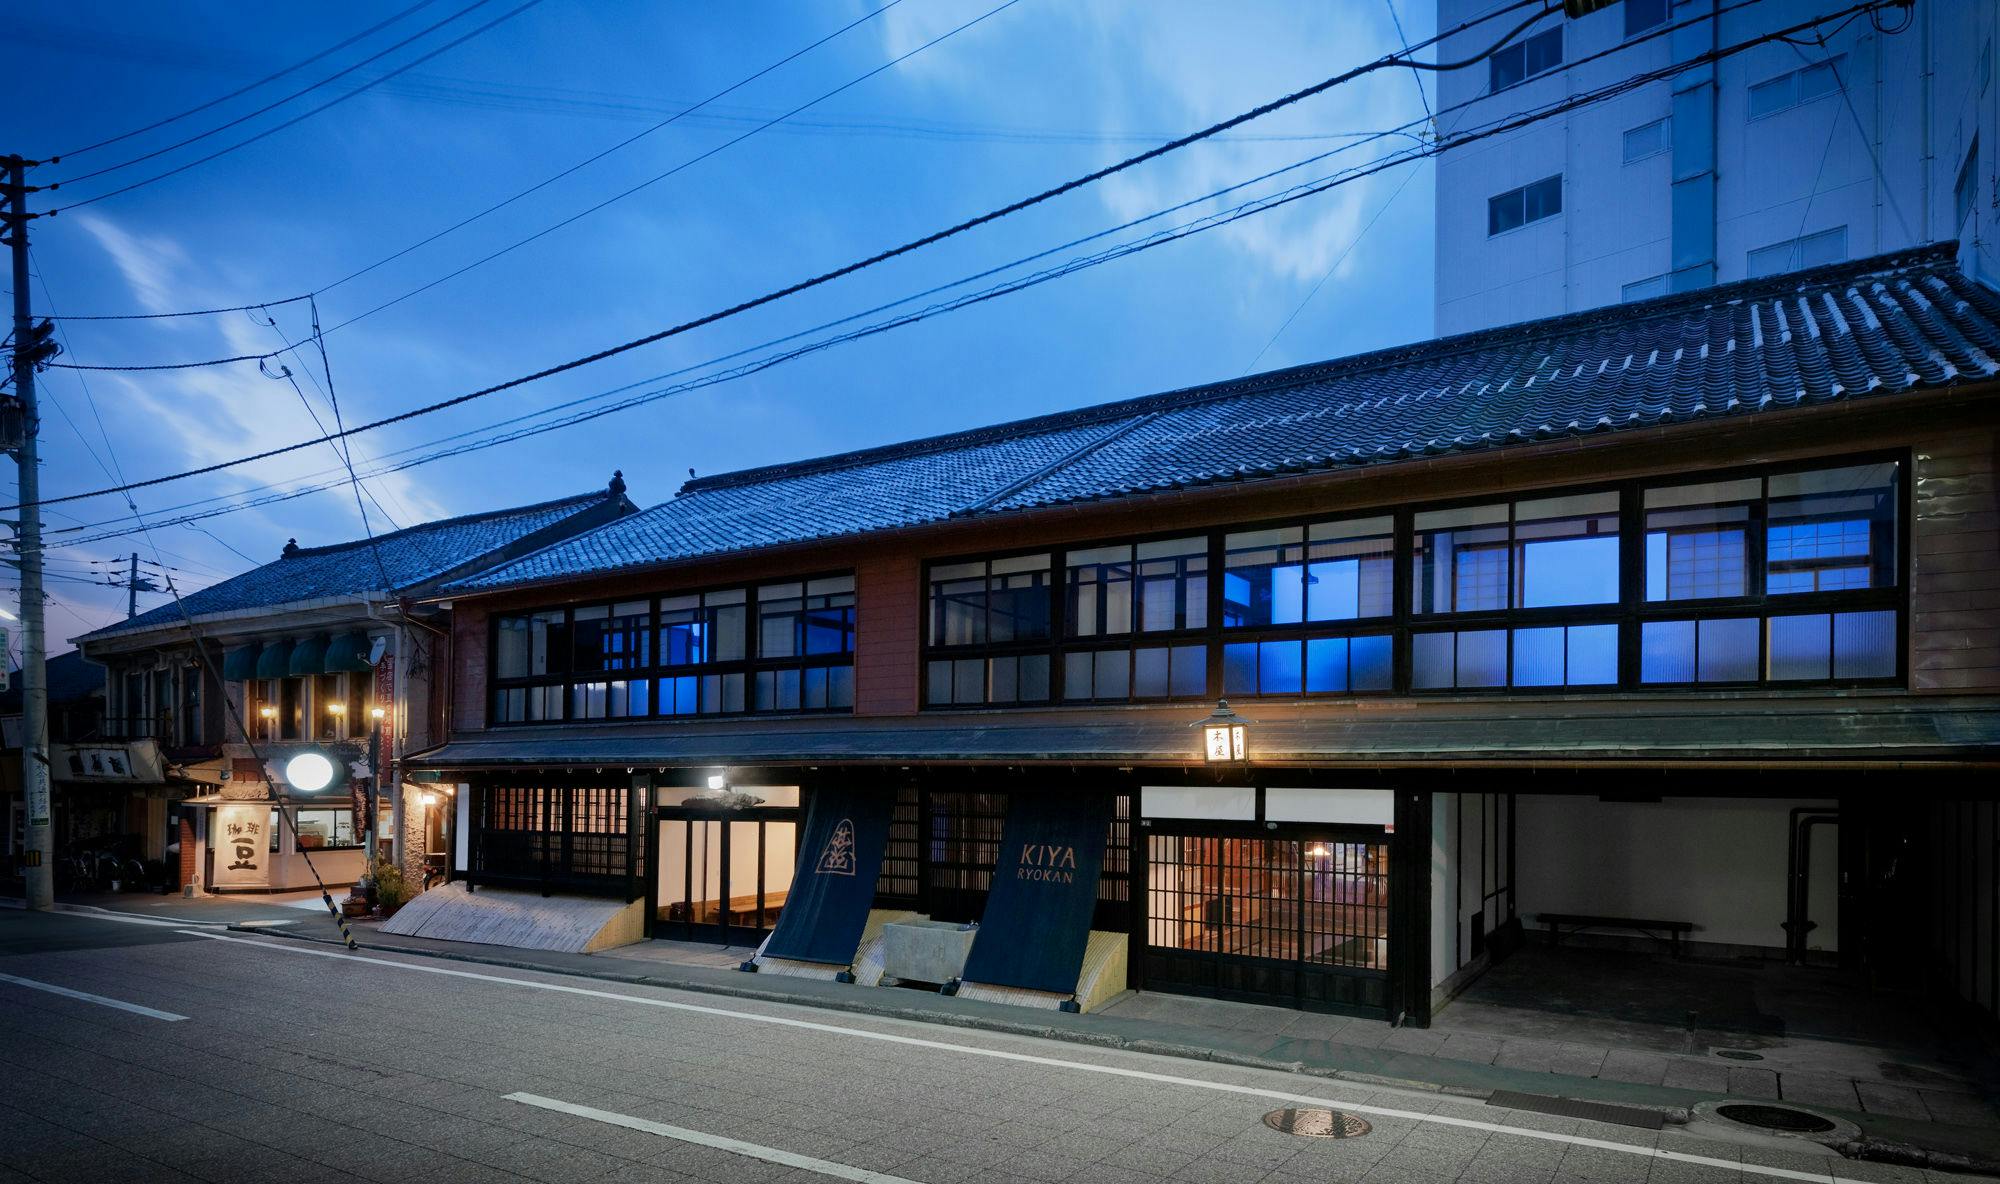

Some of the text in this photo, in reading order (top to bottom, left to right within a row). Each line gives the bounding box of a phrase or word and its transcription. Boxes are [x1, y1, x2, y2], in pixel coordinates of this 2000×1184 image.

[1212, 730, 1225, 757] 木屋
[226, 821, 260, 836] 珈琲
[227, 837, 258, 871] 豆
[1019, 843, 1077, 869] KIYA
[1016, 867, 1074, 884] RYOKAN
